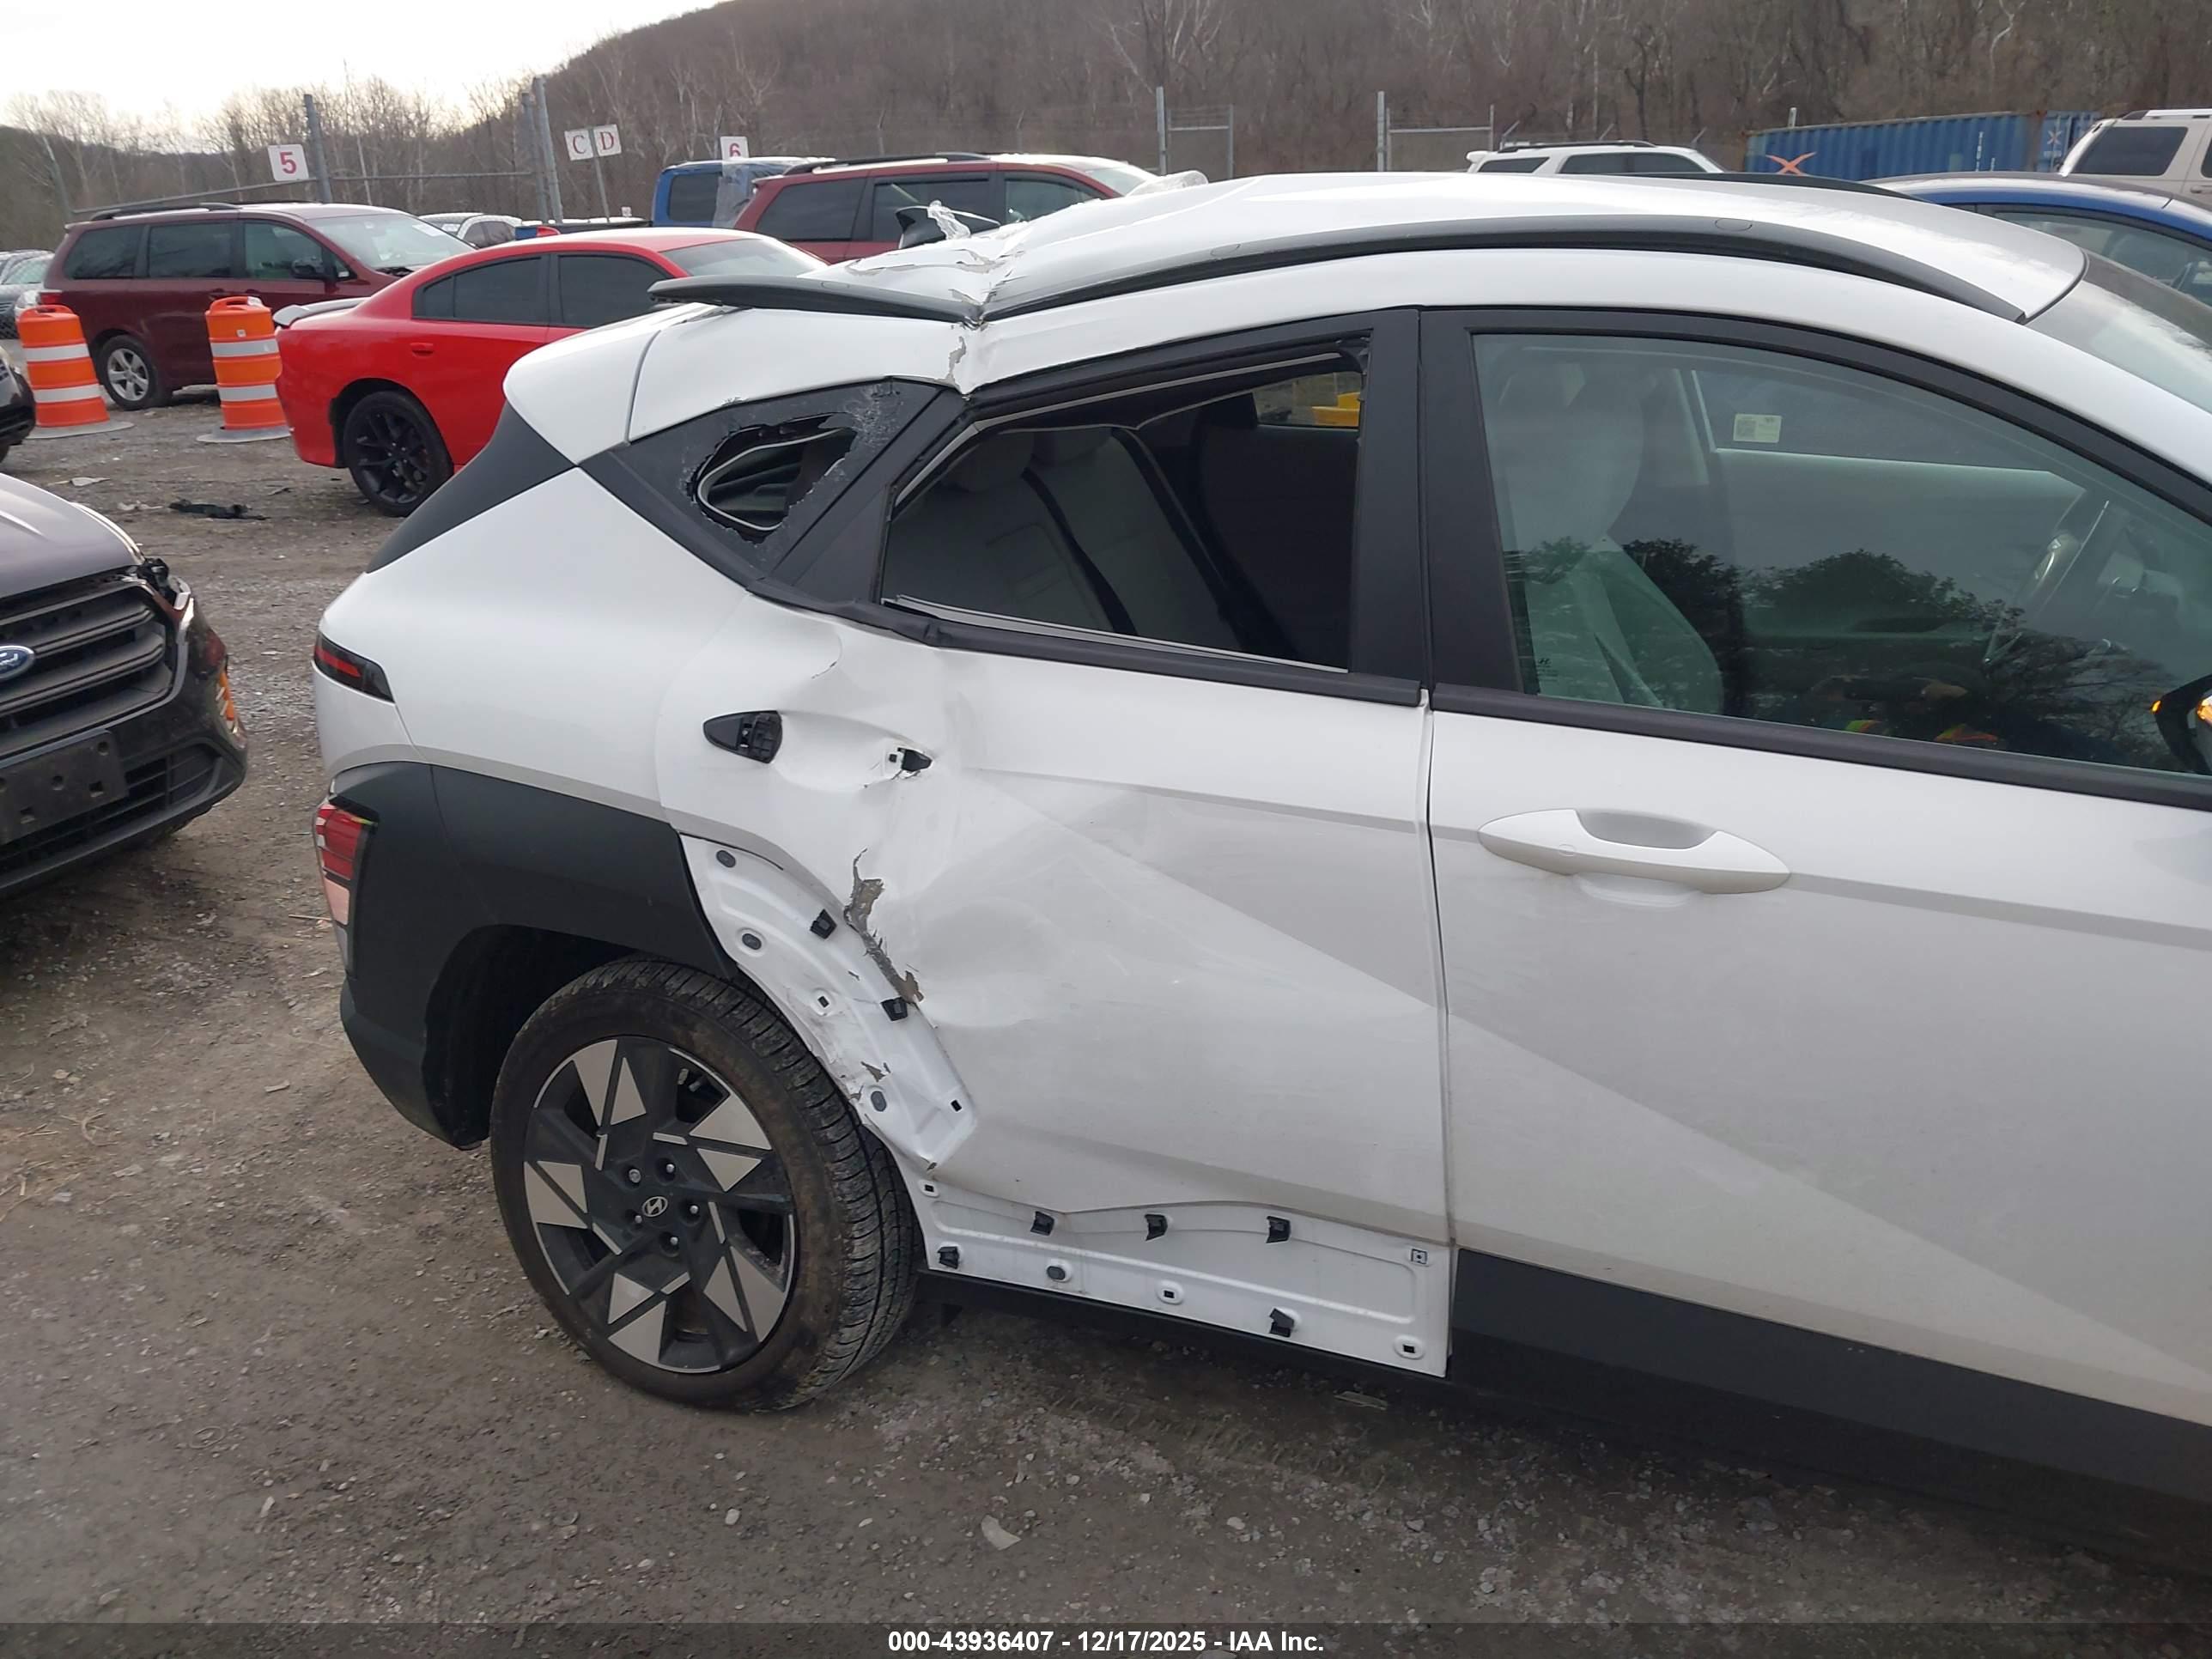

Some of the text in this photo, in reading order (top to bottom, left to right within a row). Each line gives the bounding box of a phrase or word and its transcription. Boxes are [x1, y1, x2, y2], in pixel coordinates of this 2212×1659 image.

[572, 135, 586, 155] C
[599, 131, 615, 150] D
[280, 151, 297, 174] 5
